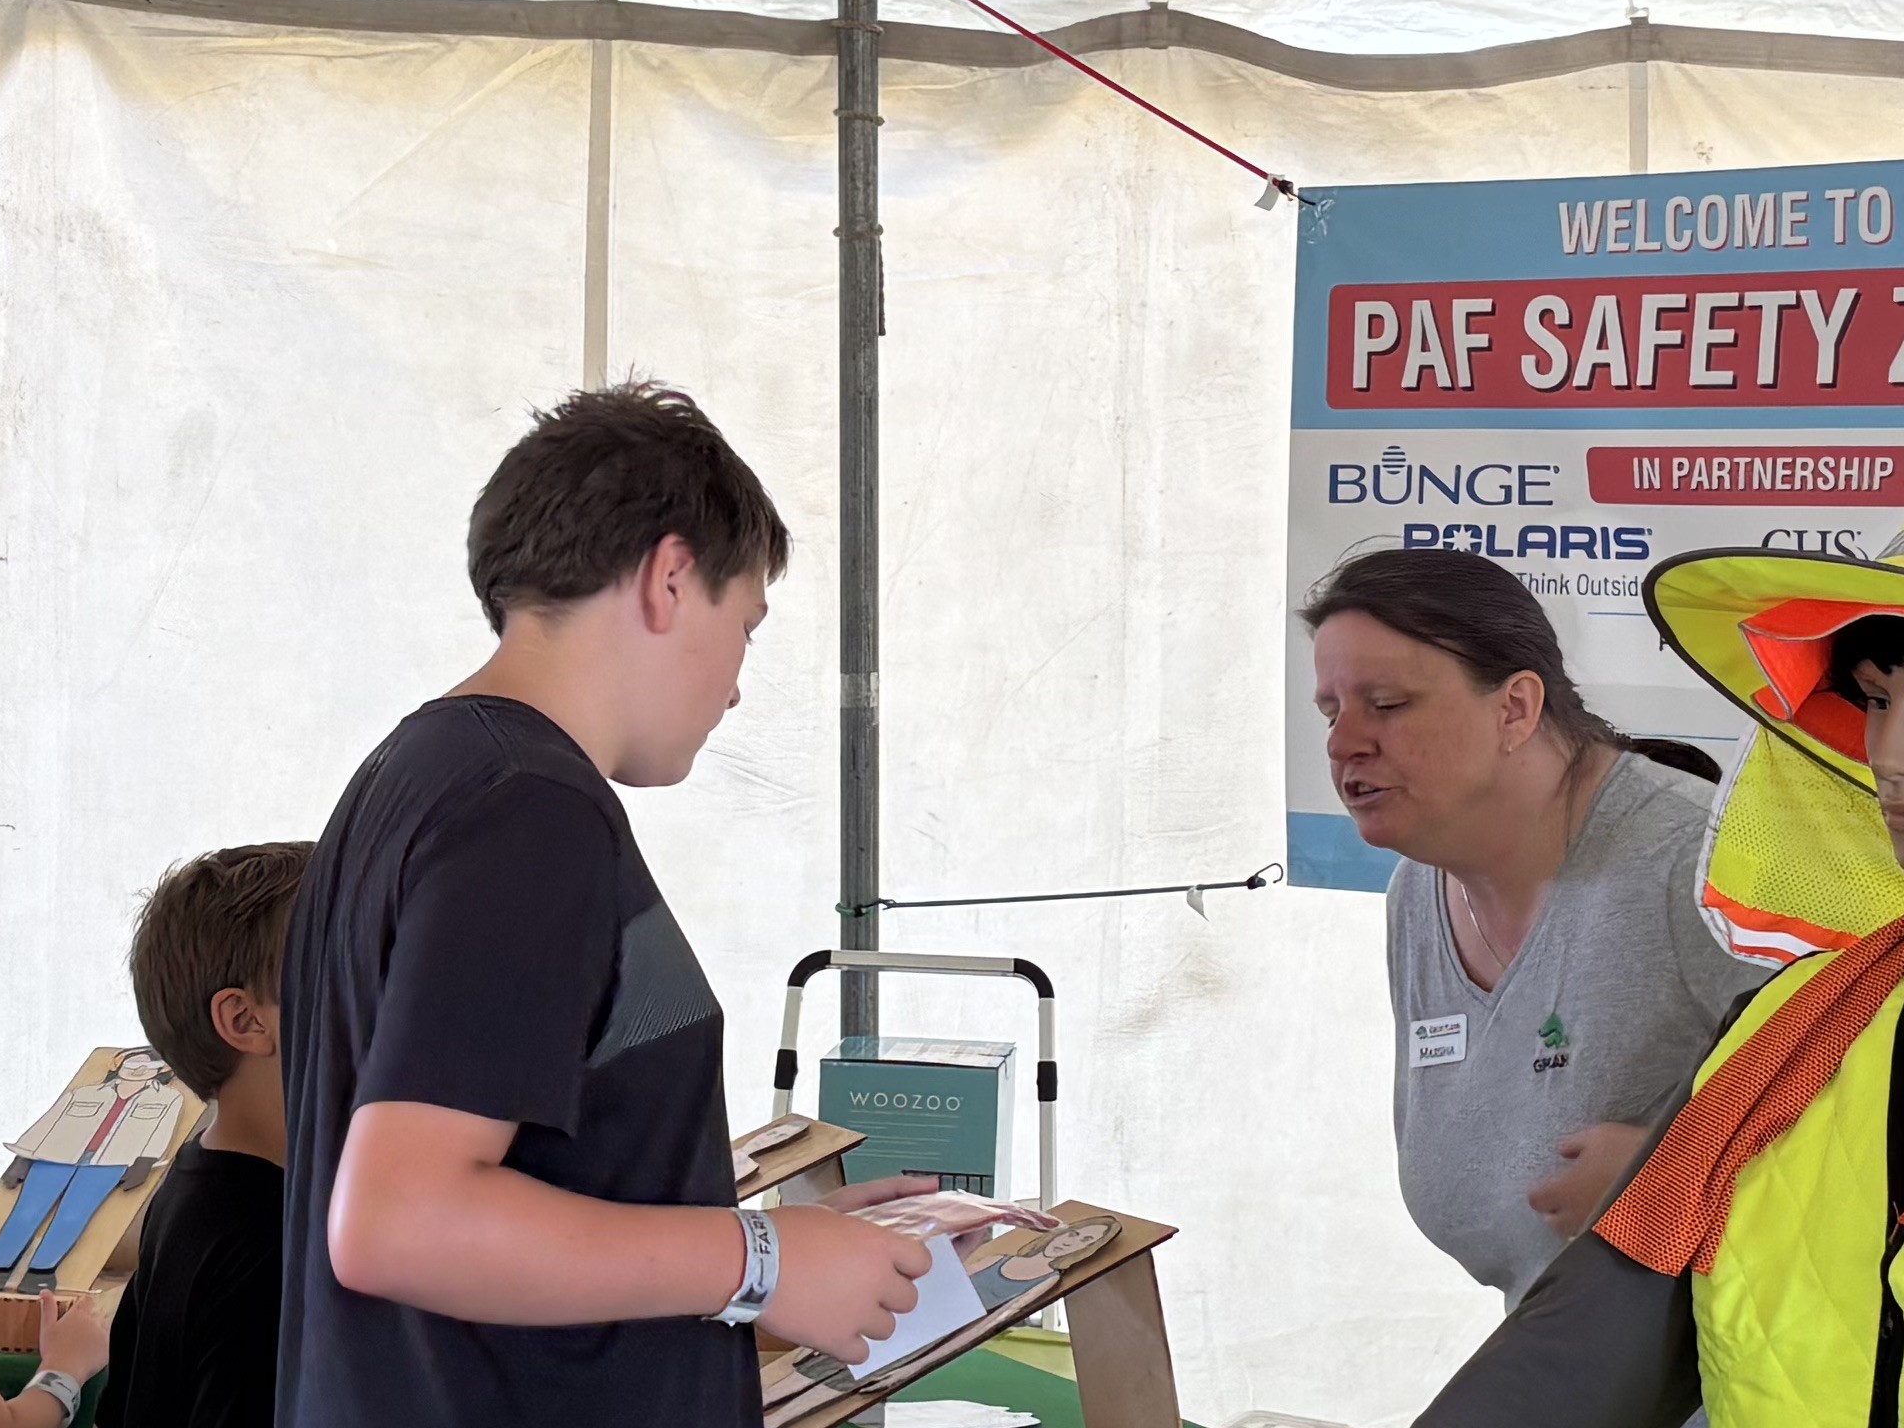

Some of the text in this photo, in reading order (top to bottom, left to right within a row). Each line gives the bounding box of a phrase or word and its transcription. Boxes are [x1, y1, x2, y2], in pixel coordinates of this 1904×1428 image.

[1559, 186, 1893, 255] WELCOME TO
[1352, 297, 1495, 390] PAF
[1521, 288, 1860, 391] SAFETY
[1633, 457, 1661, 490] IN
[1672, 456, 1894, 491] PARTNERSHIP
[1403, 523, 1650, 560] POLARIS
[1518, 572, 1641, 598] Think Outsid
[849, 1091, 961, 1112] WOOZOO
